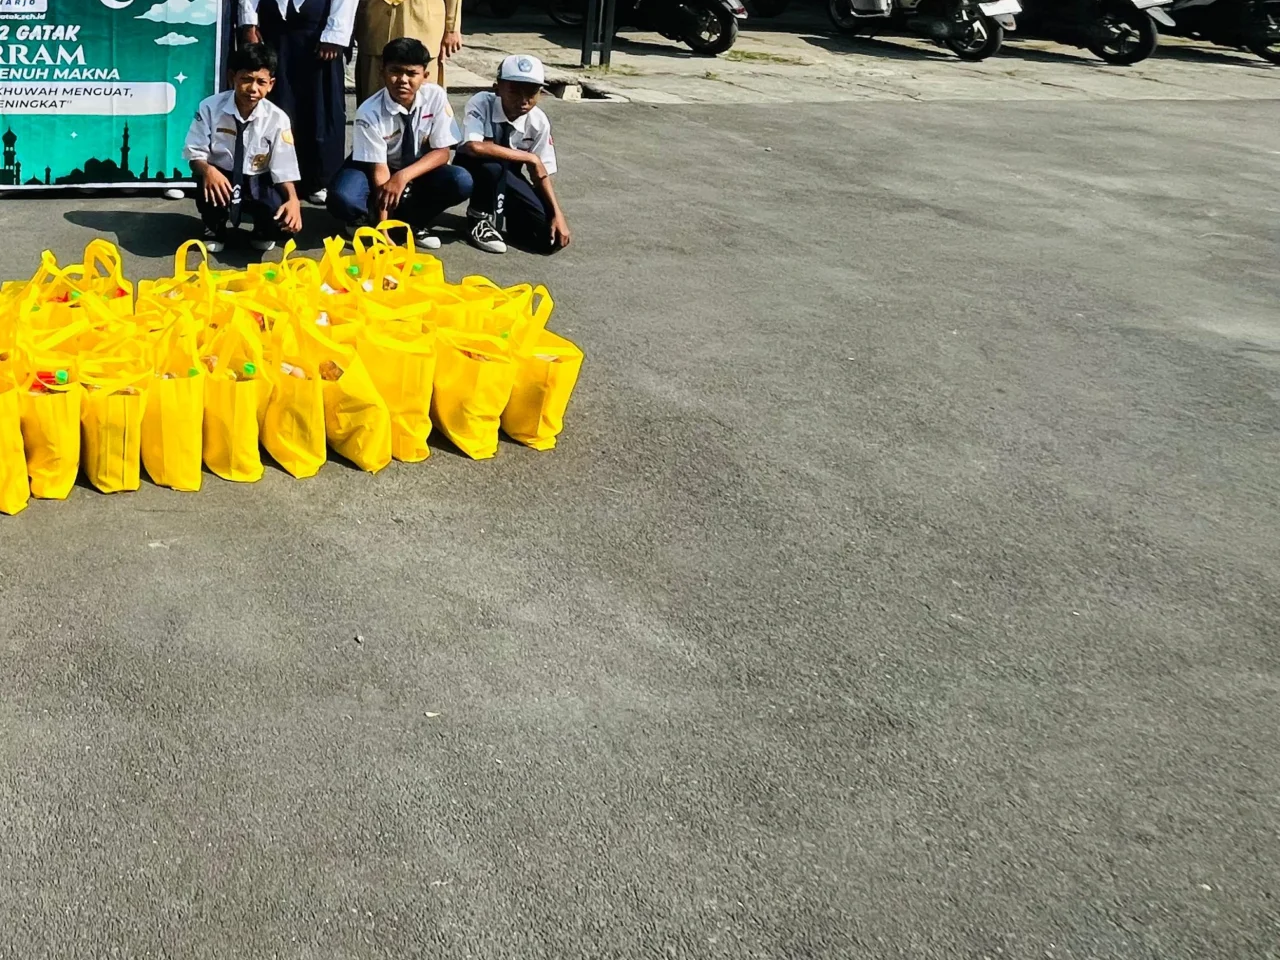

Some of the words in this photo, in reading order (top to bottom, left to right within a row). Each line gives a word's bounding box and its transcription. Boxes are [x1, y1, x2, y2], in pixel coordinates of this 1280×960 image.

[16, 25, 81, 42] GATAK
[53, 68, 120, 80] MAKNA
[62, 87, 134, 98] MENGUAT,
